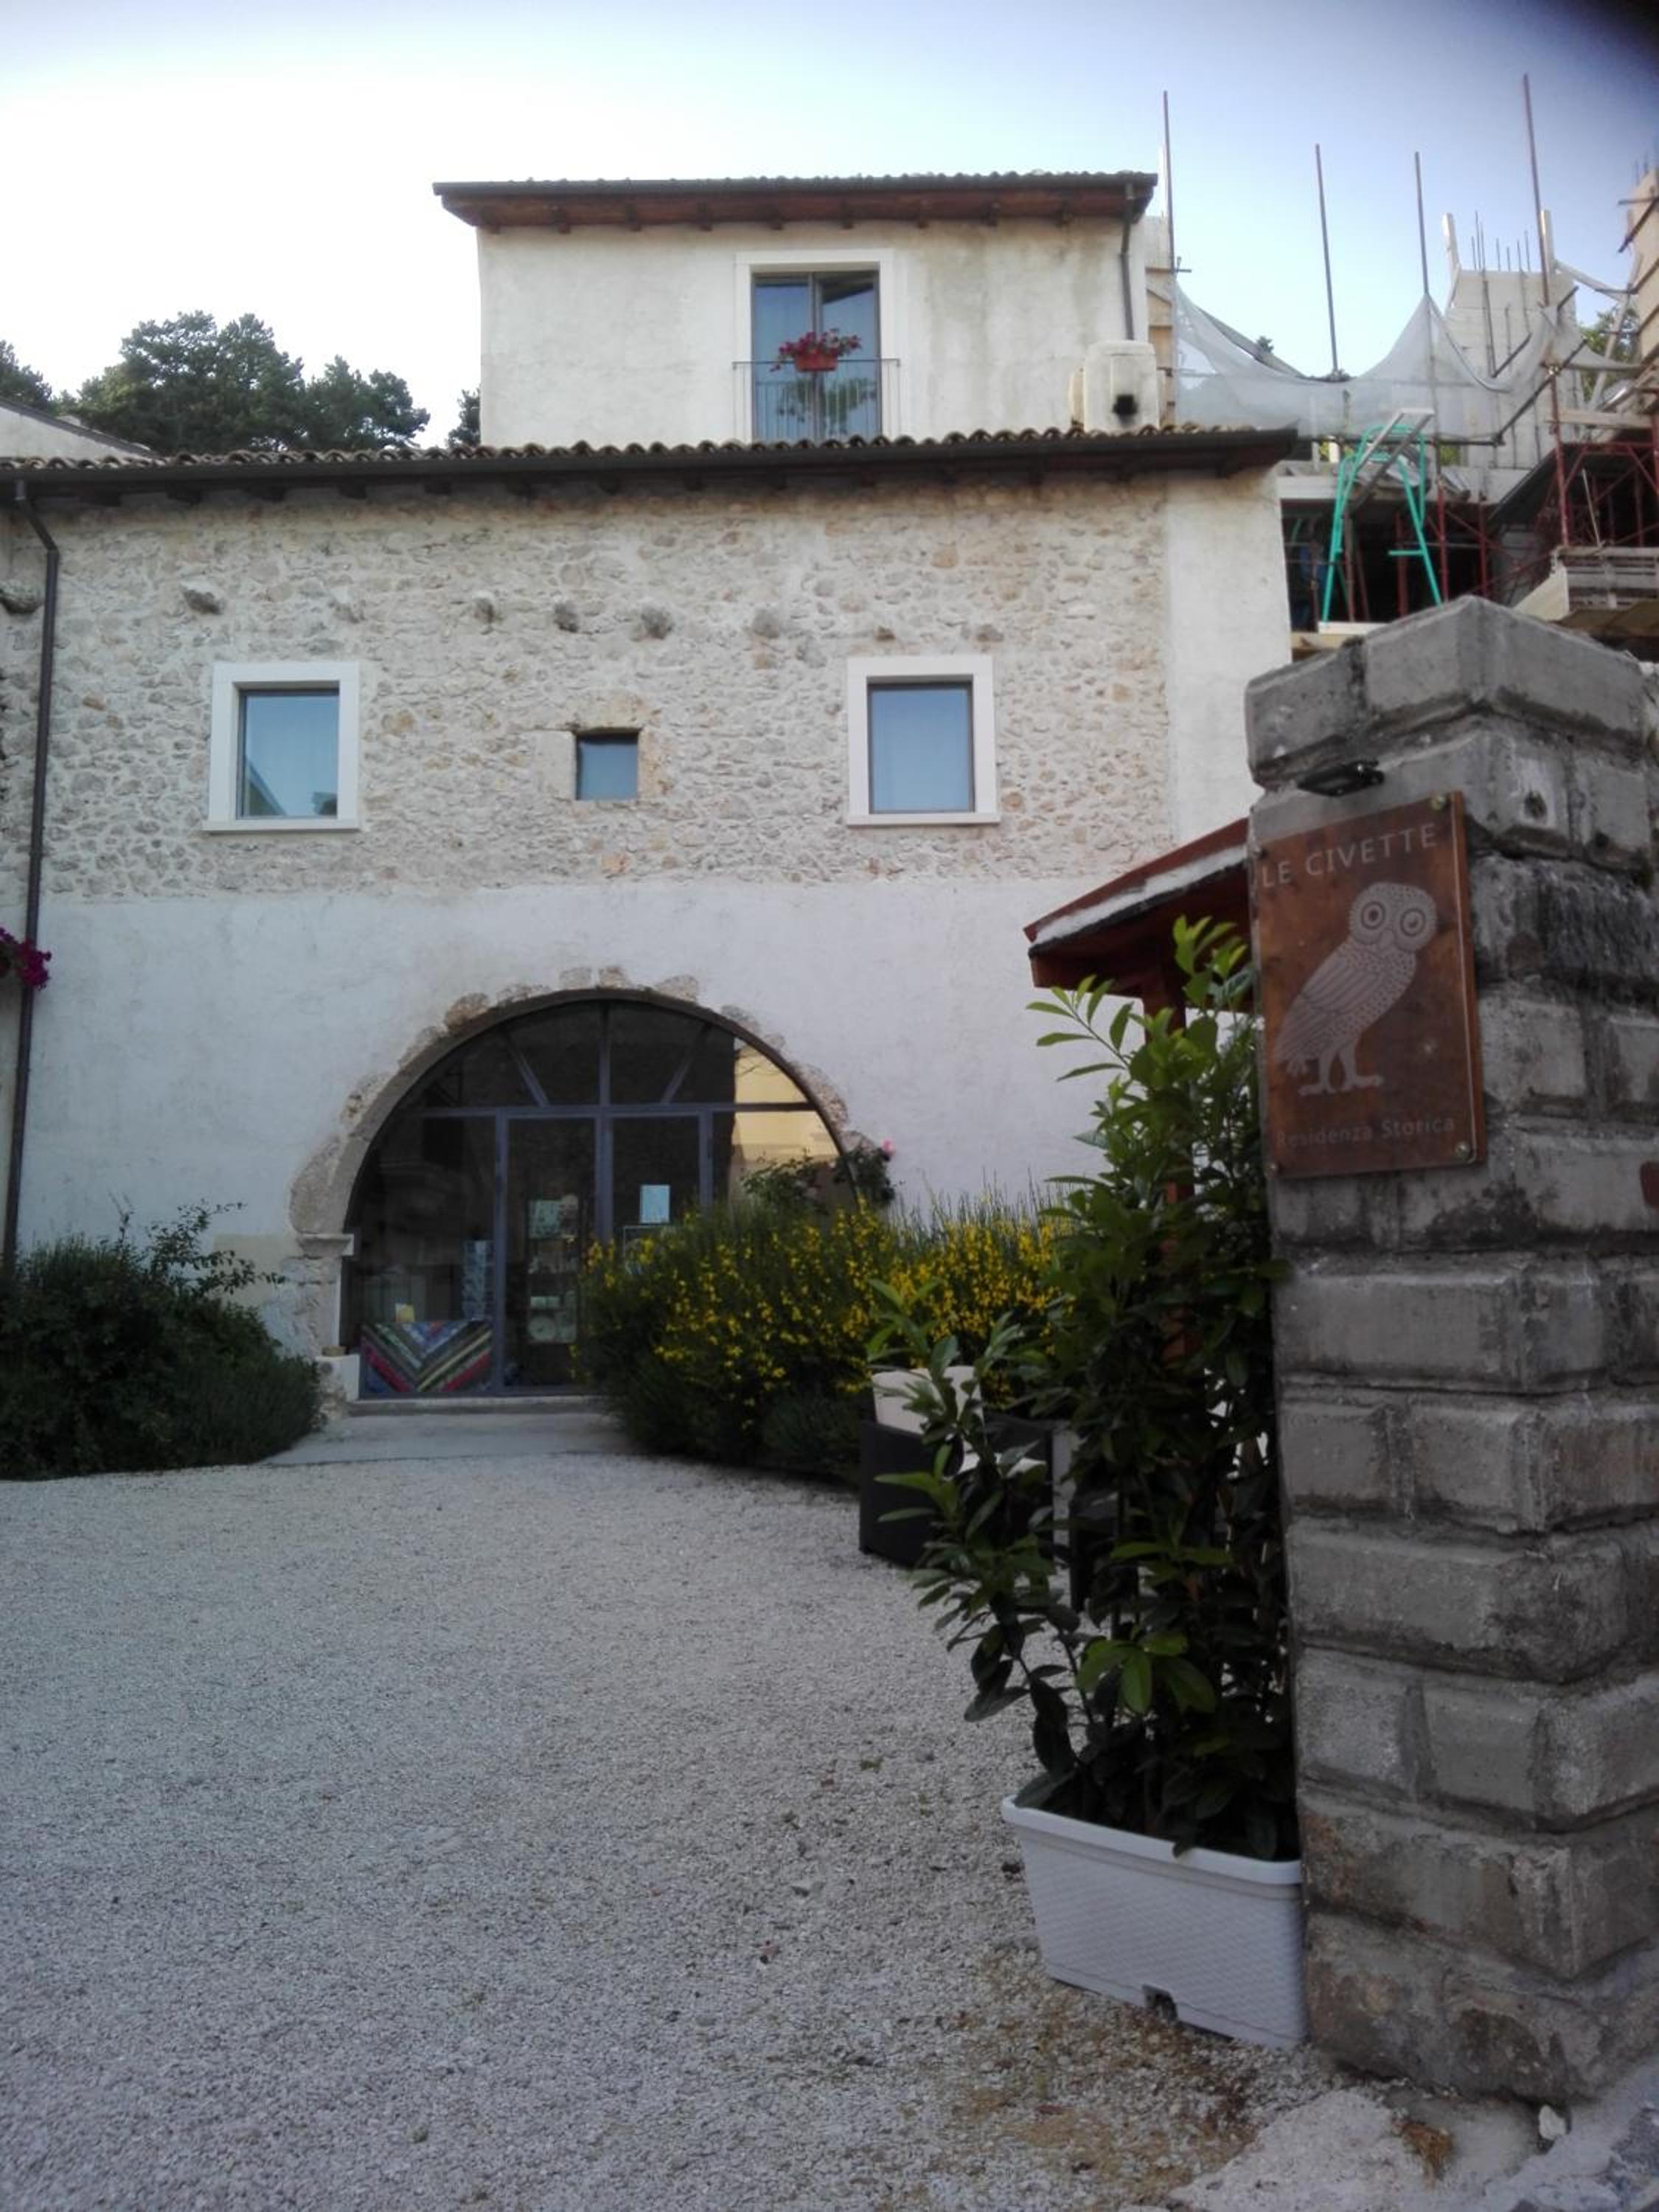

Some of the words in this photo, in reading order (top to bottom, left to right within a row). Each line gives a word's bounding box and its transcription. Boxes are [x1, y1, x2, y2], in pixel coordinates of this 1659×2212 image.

[1261, 860, 1291, 888] LE
[1304, 822, 1437, 876] CIVETTE
[1276, 1124, 1373, 1147] Residenza
[1380, 1117, 1455, 1139] Storica
